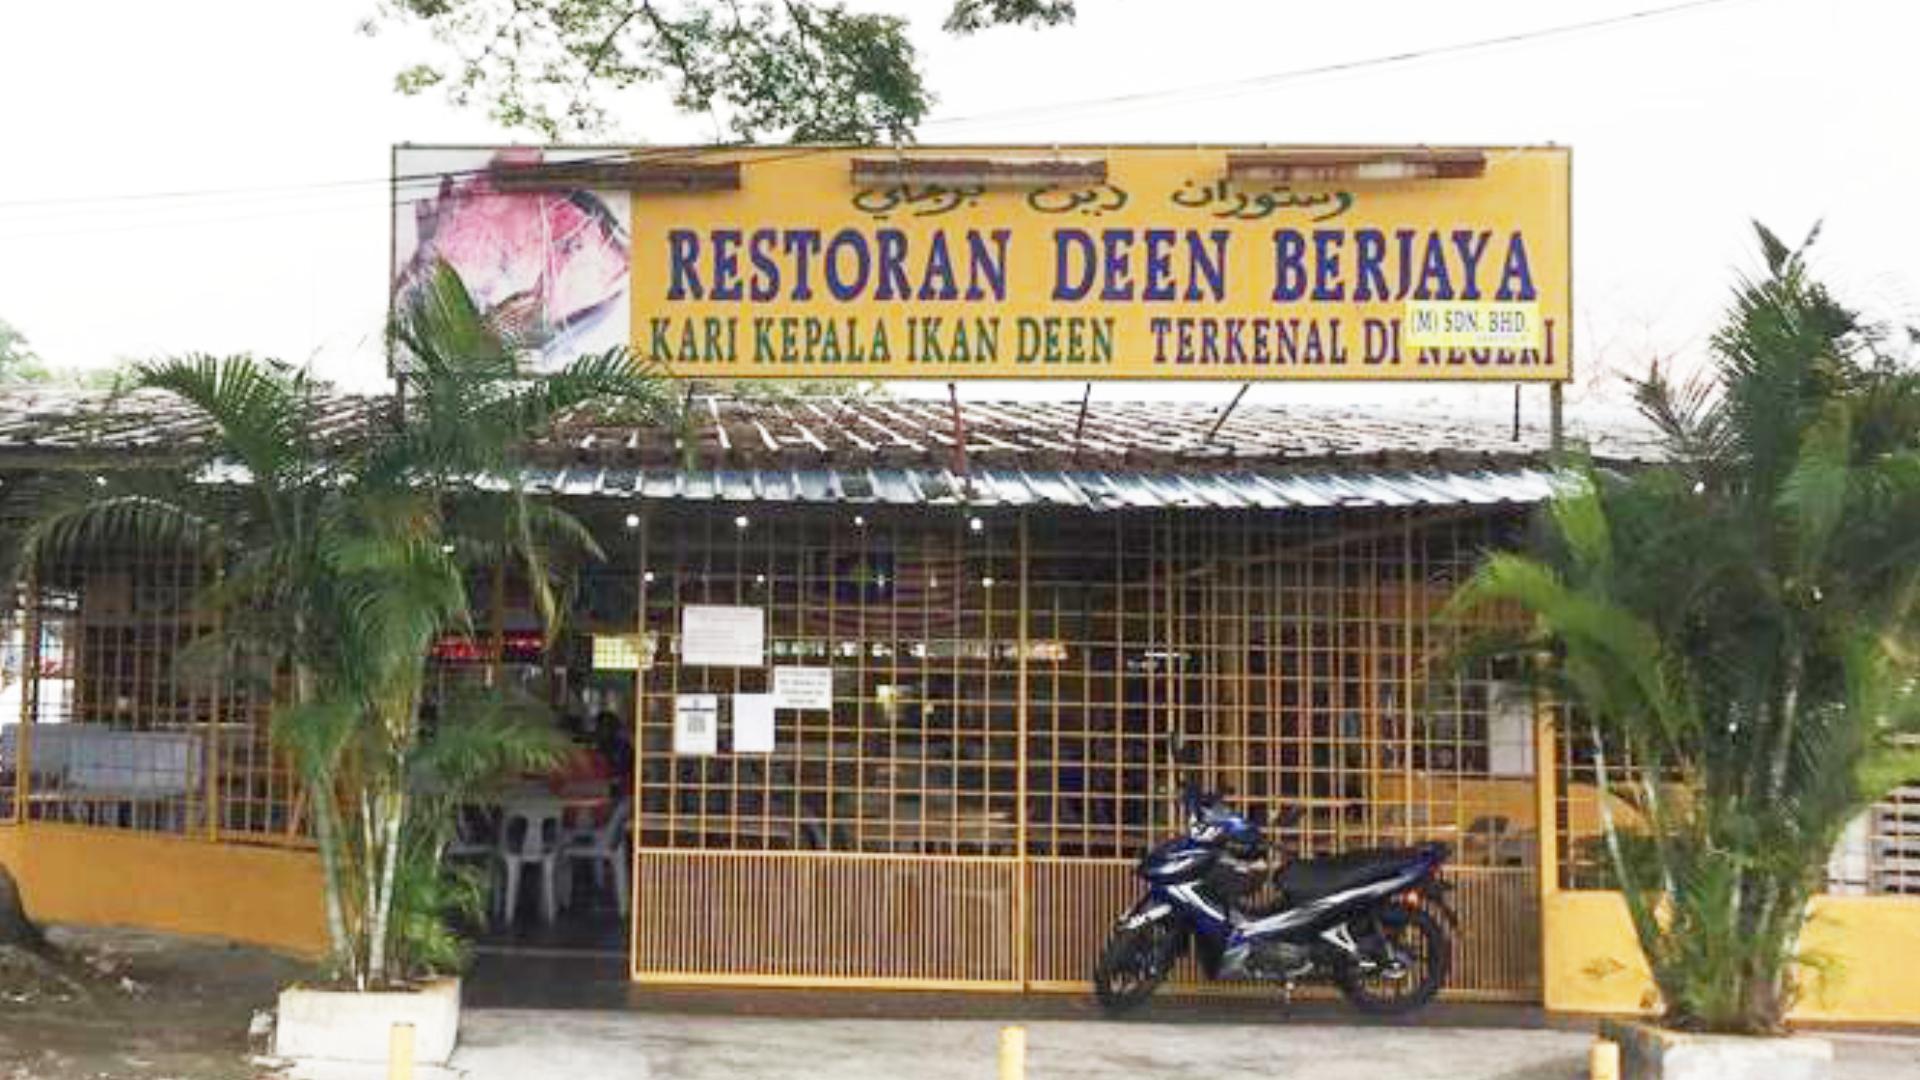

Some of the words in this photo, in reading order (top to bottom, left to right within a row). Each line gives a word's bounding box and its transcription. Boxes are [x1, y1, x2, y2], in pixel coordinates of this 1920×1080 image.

[666, 229, 1012, 302] RESTORAN
[1052, 229, 1230, 302] DEEN
[1271, 229, 1537, 302] BERJAYA
[650, 317, 738, 363] KARI
[752, 317, 891, 364] KEPALA
[906, 317, 1000, 363] IKAN
[1015, 317, 1114, 363] DEEN
[1150, 317, 1348, 365] TERKENAL
[1362, 317, 1402, 365] DI
